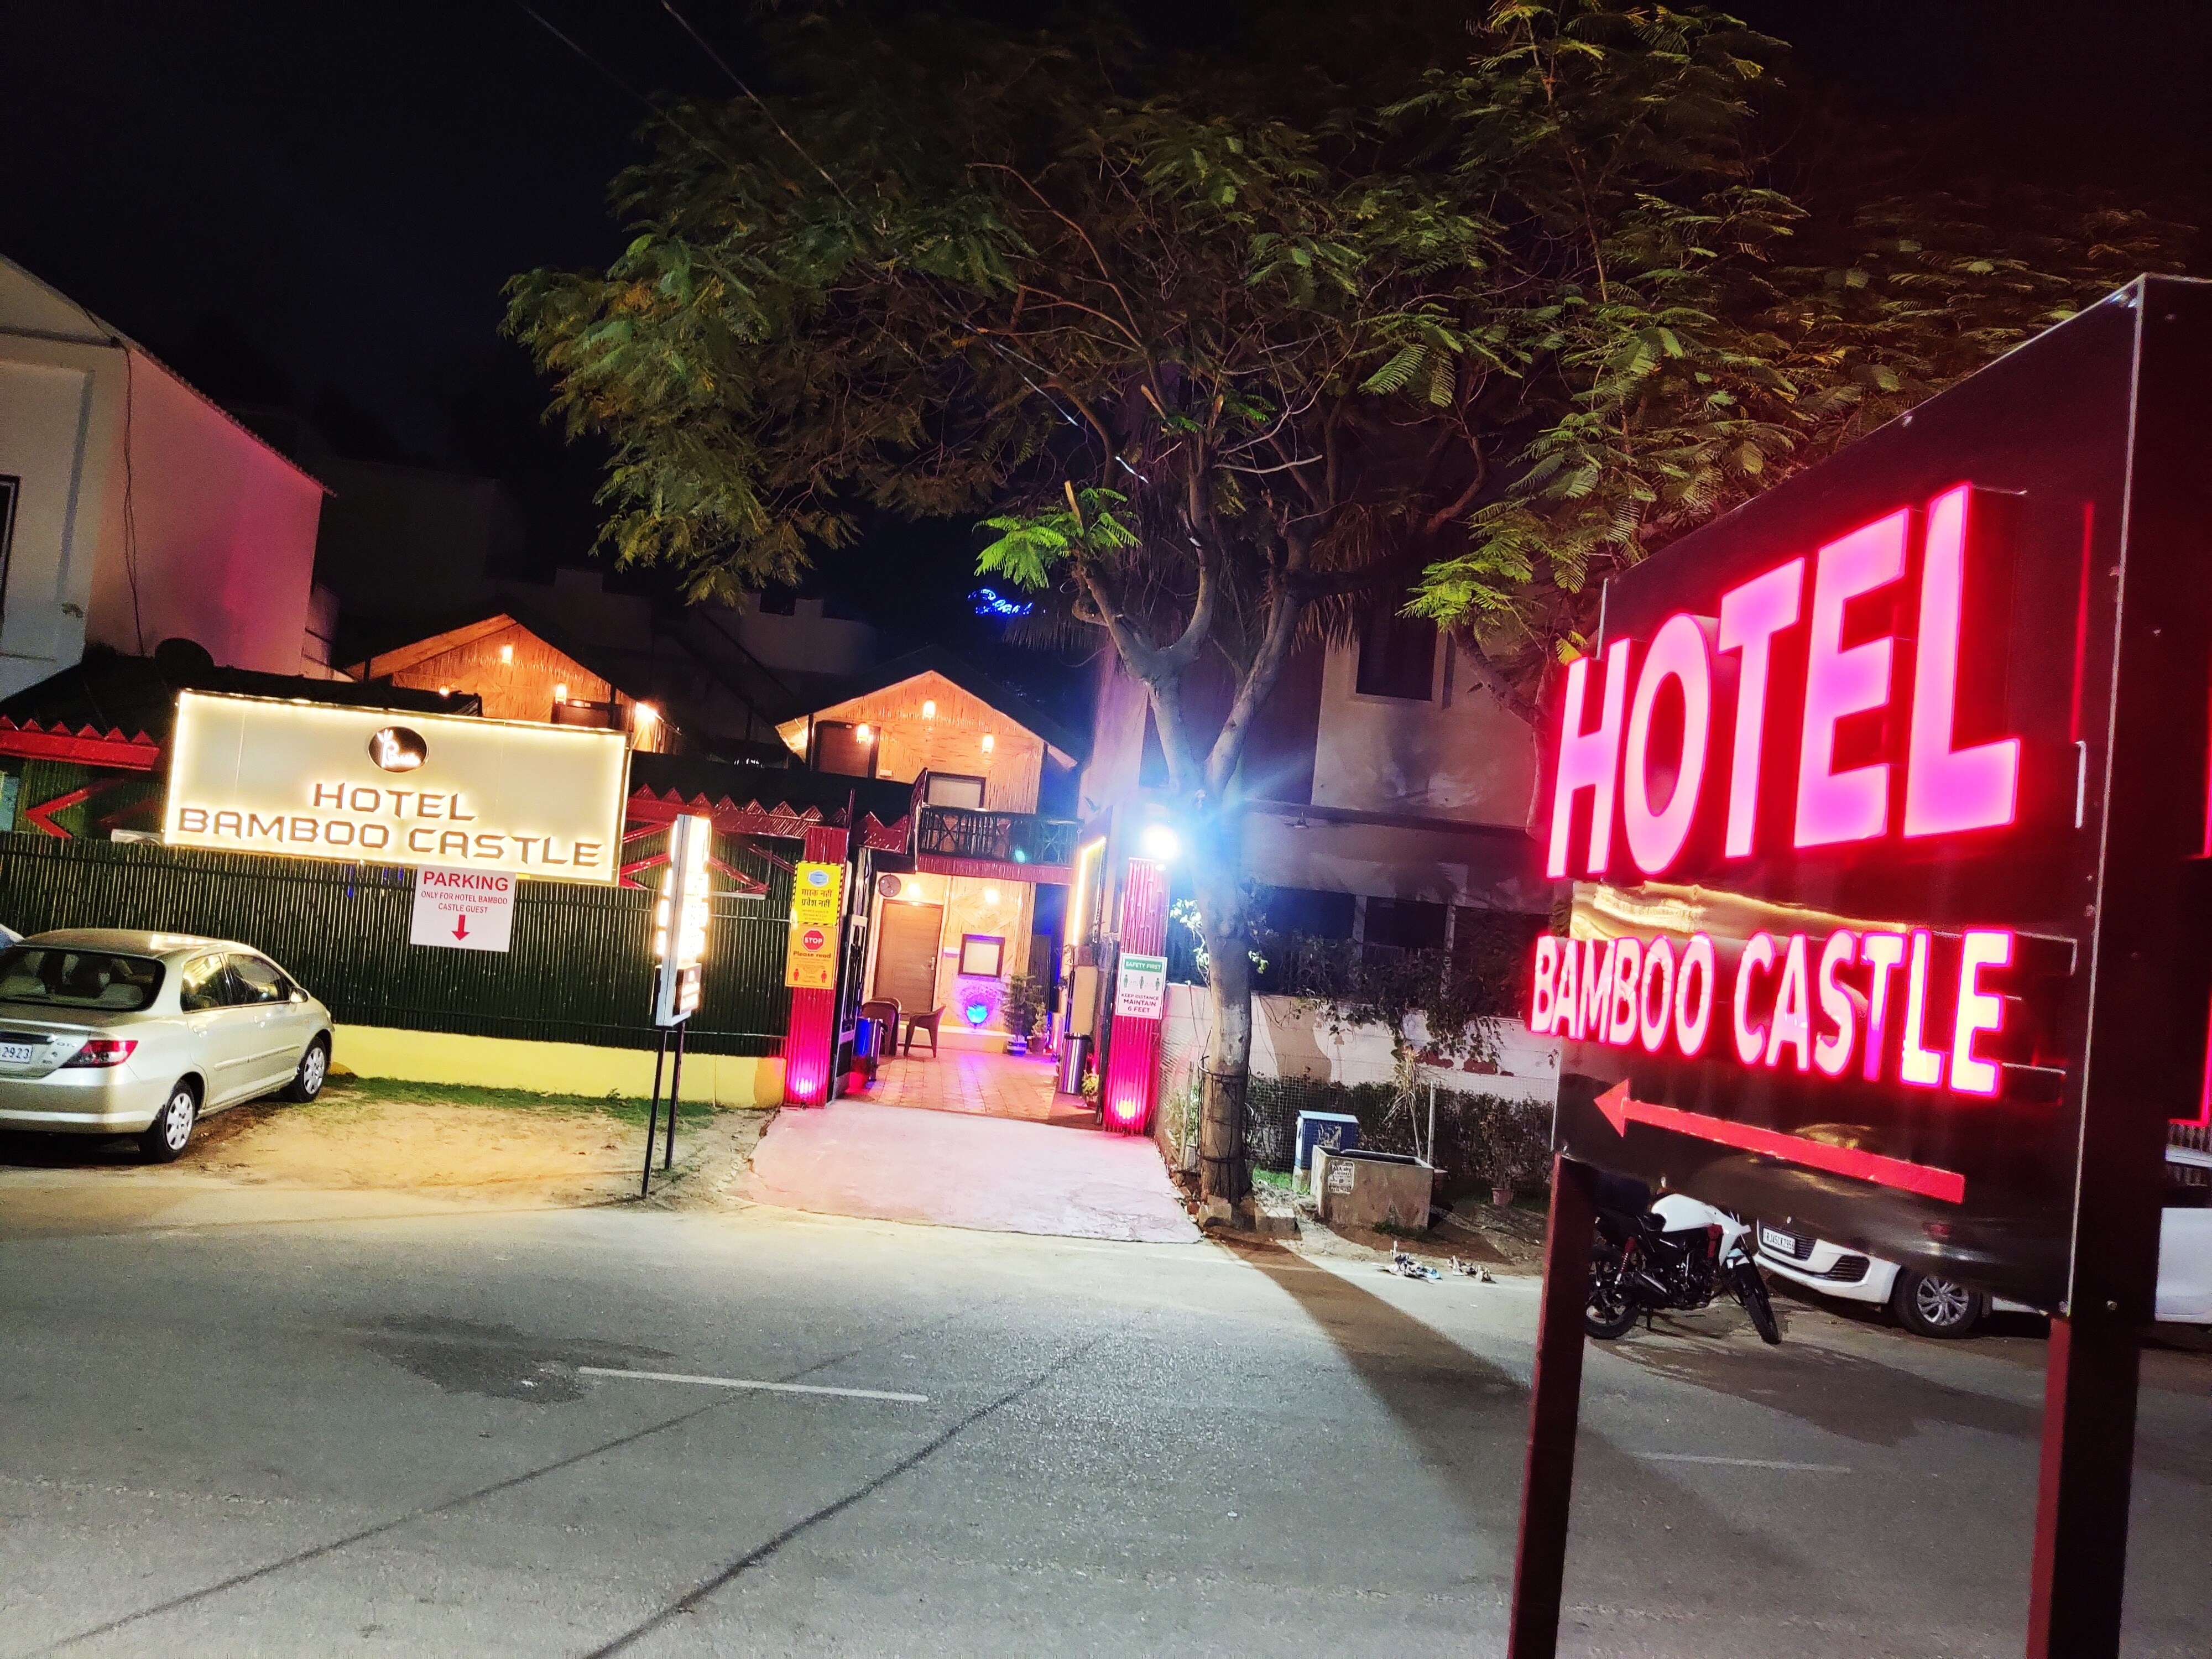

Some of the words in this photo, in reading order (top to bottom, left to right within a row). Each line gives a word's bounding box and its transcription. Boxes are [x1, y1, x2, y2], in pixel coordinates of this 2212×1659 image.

[1547, 482, 2021, 879] HOTEL
[313, 782, 479, 821] HOTEL
[178, 807, 389, 849] BAMBOO
[408, 828, 603, 867] CASTLE
[423, 870, 508, 890] PARKING
[421, 890, 438, 899] ONLY
[455, 894, 476, 902] HOTEL
[478, 895, 507, 904] BAMBOO
[438, 902, 463, 911] CASTLE
[1123, 998, 1156, 1006] MAINTAIN
[1531, 930, 1717, 1057] BAMBOO
[1733, 928, 2017, 1098] CASTLE
